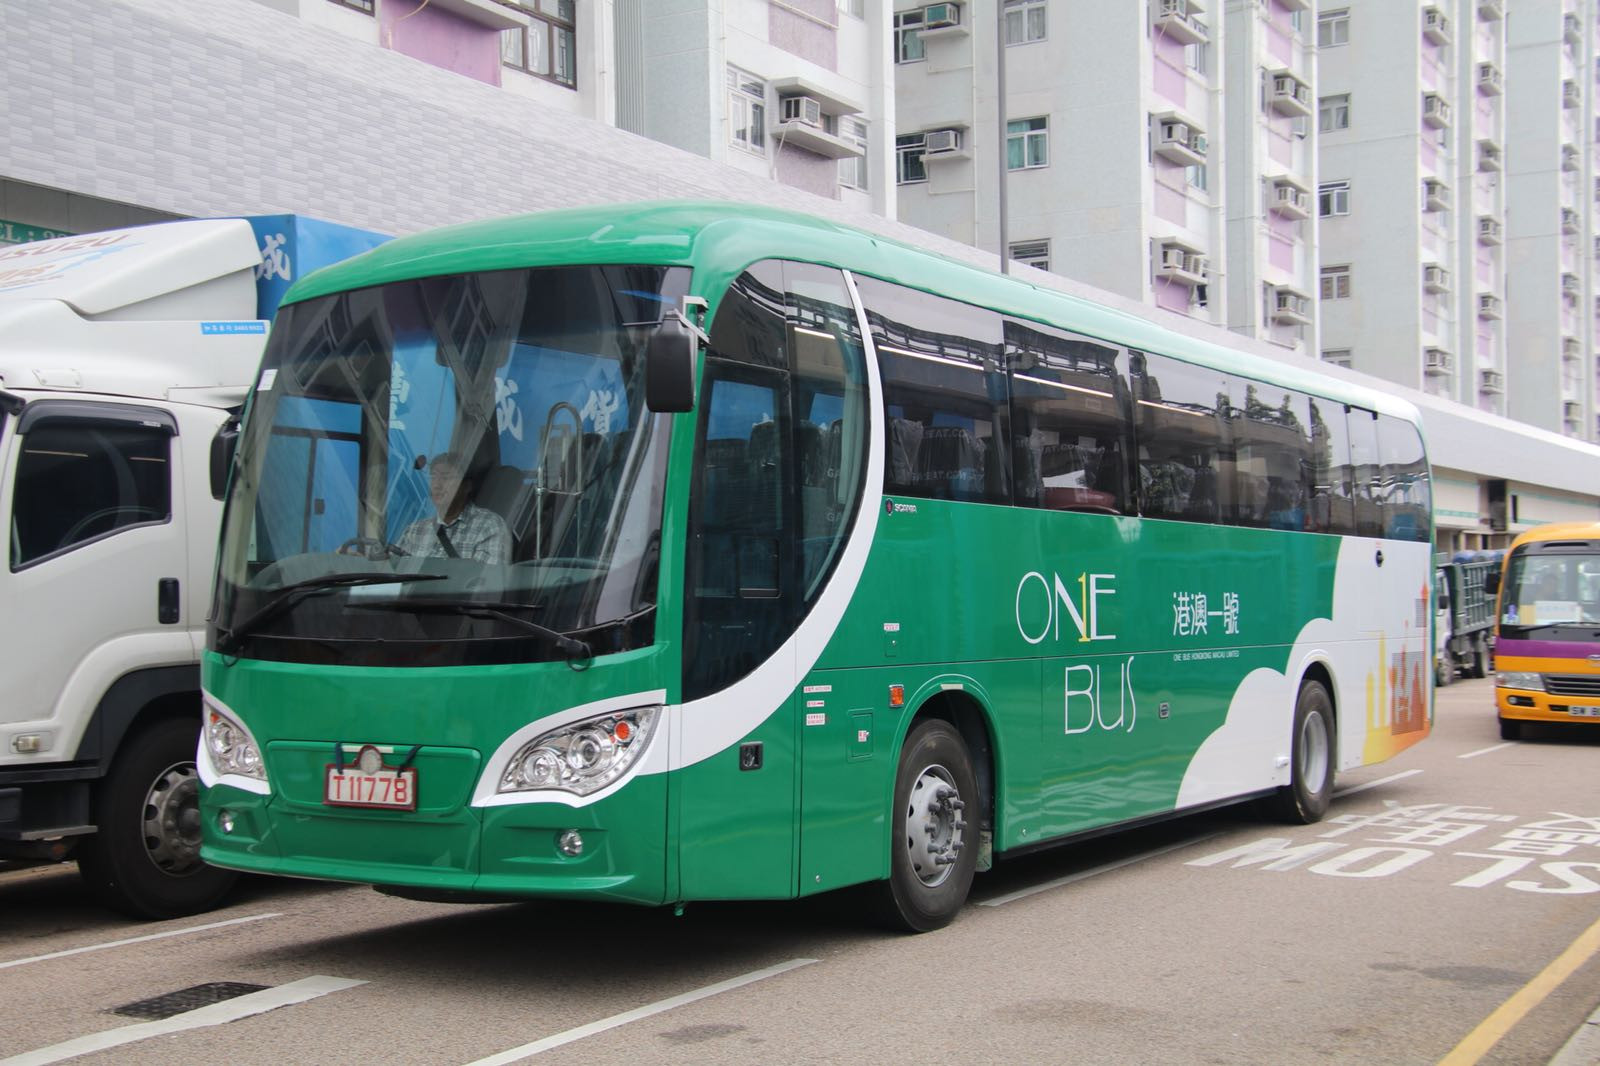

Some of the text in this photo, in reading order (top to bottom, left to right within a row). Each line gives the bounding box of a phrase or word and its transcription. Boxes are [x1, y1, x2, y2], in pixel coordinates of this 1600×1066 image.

[1173, 591, 1240, 636] 港澳一號
[1065, 655, 1136, 735] BUS
[333, 775, 408, 803] T11778
